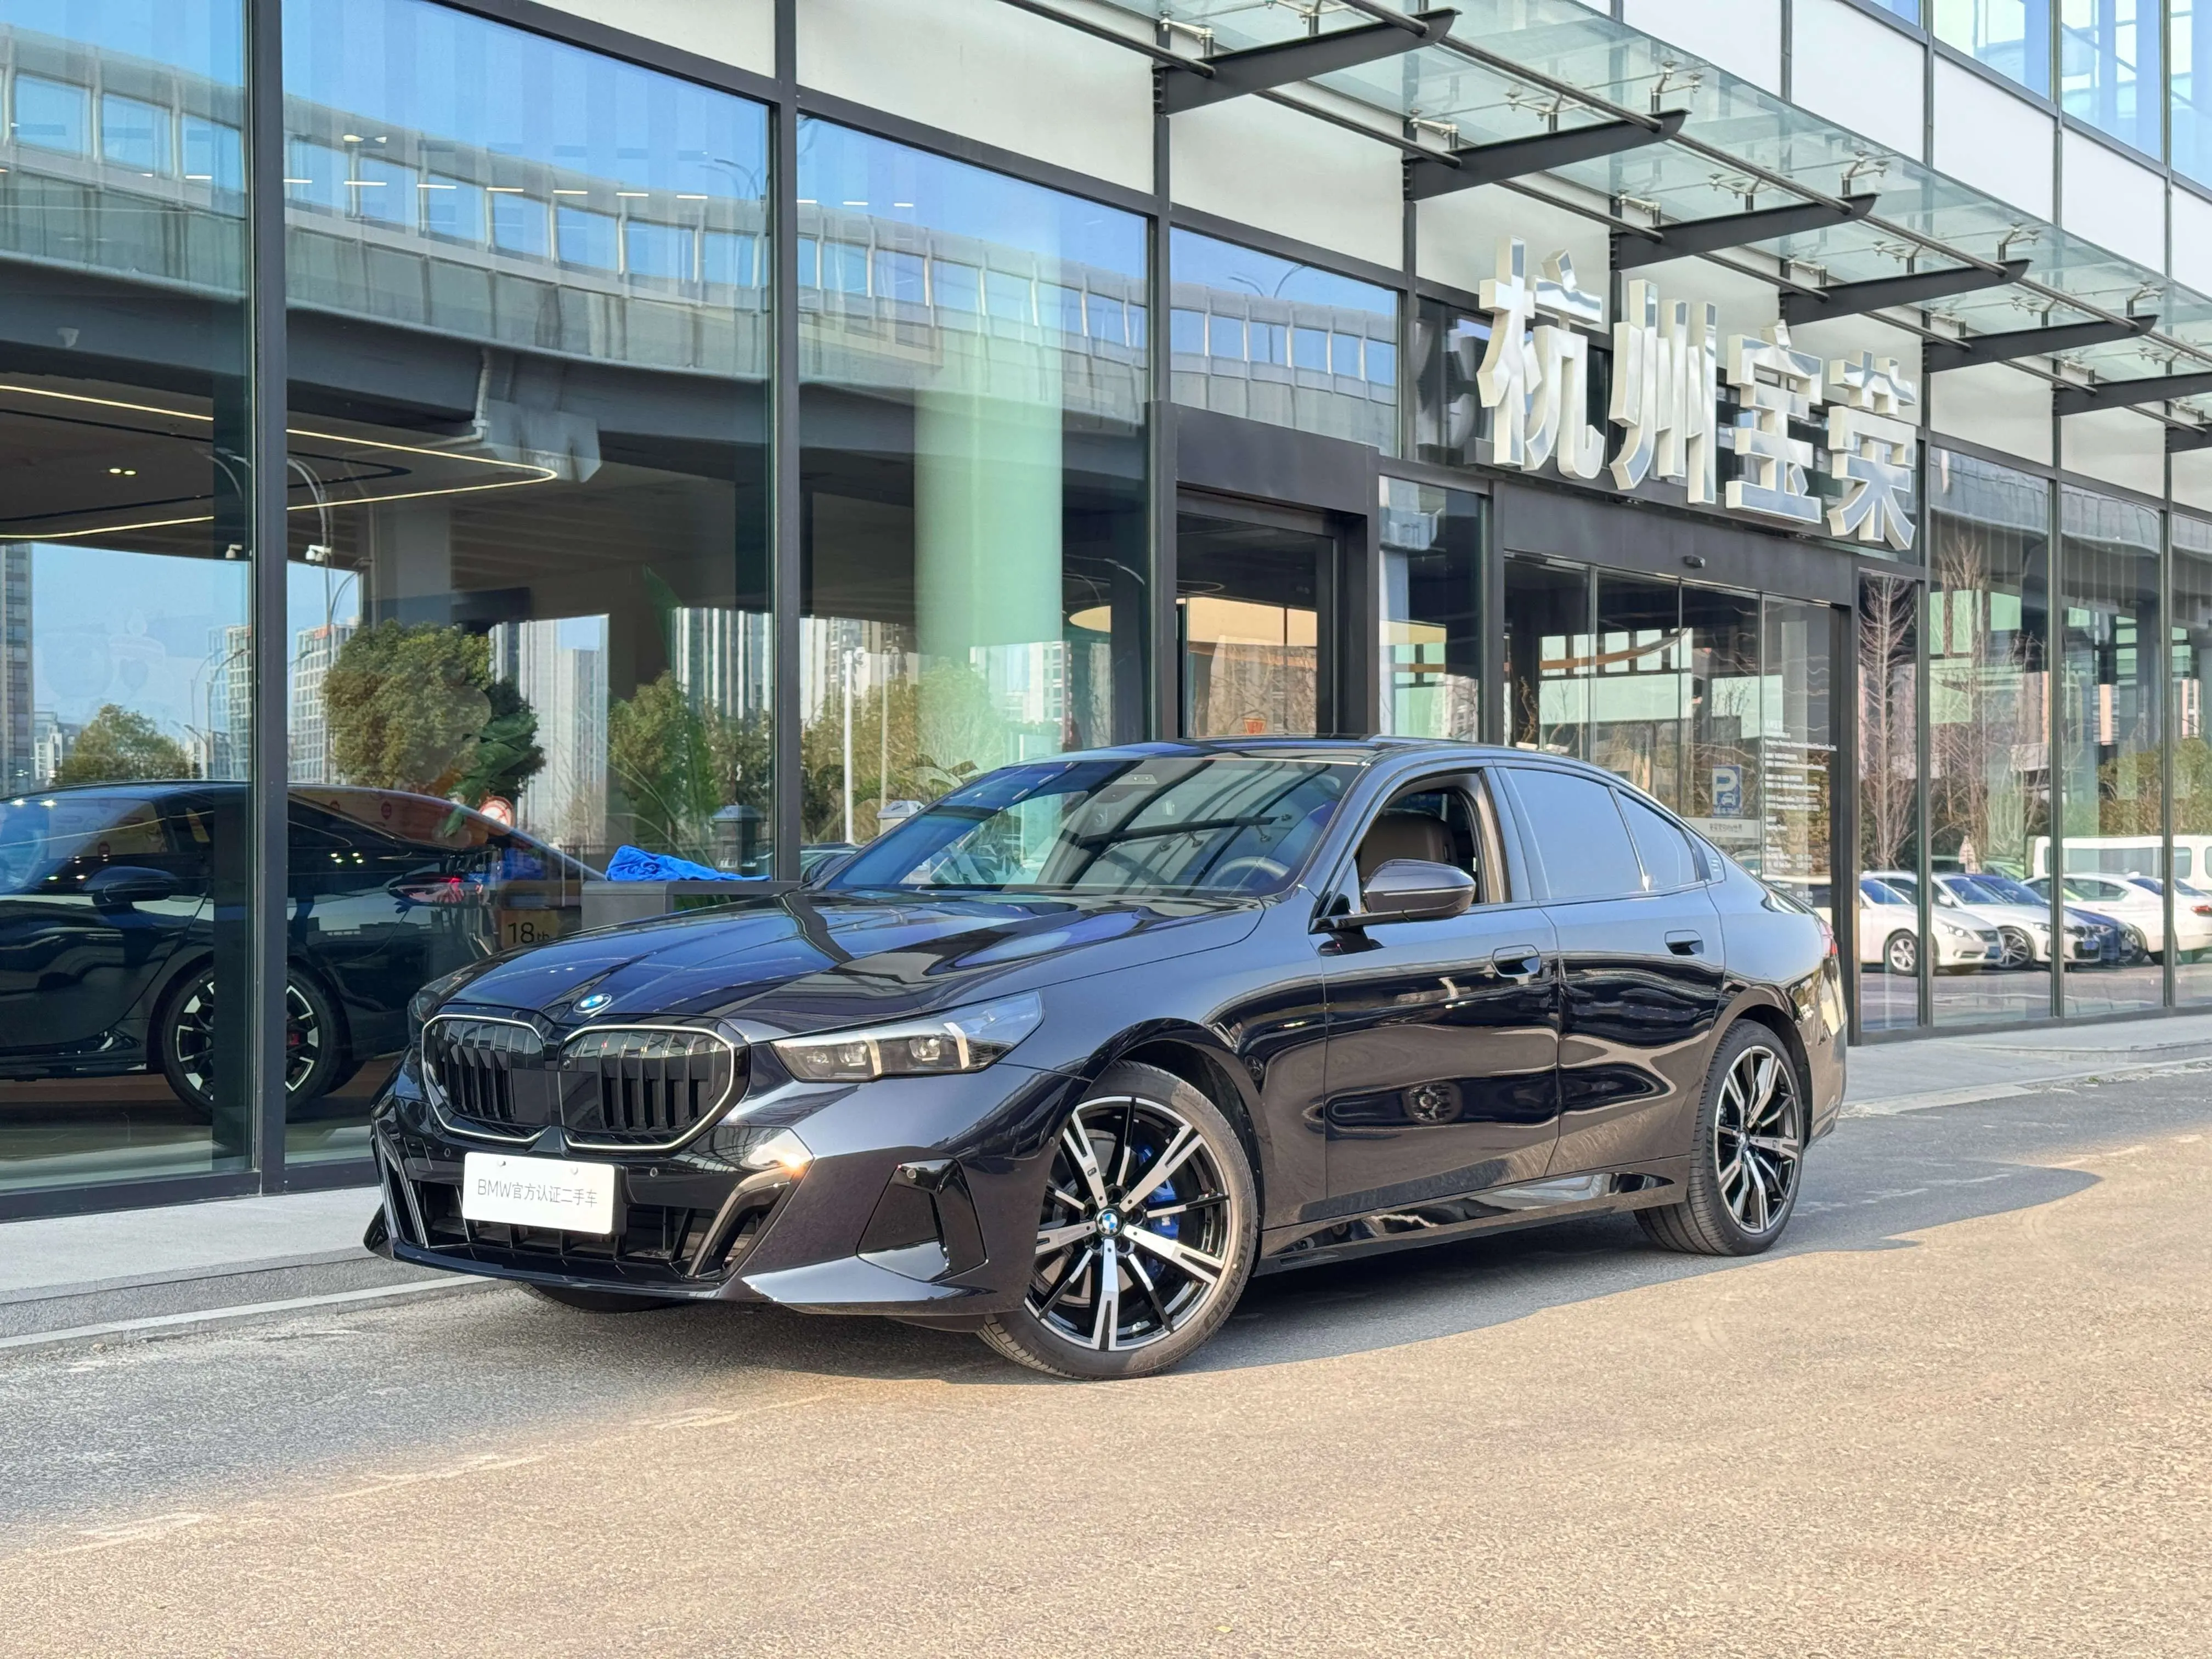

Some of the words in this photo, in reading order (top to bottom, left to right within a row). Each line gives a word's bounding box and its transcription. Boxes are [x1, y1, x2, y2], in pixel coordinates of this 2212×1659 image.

[1477, 235, 1916, 550] 杭州宝荣
[1712, 768, 1737, 805] P
[478, 1179, 597, 1207] BMW官方认证二手车
